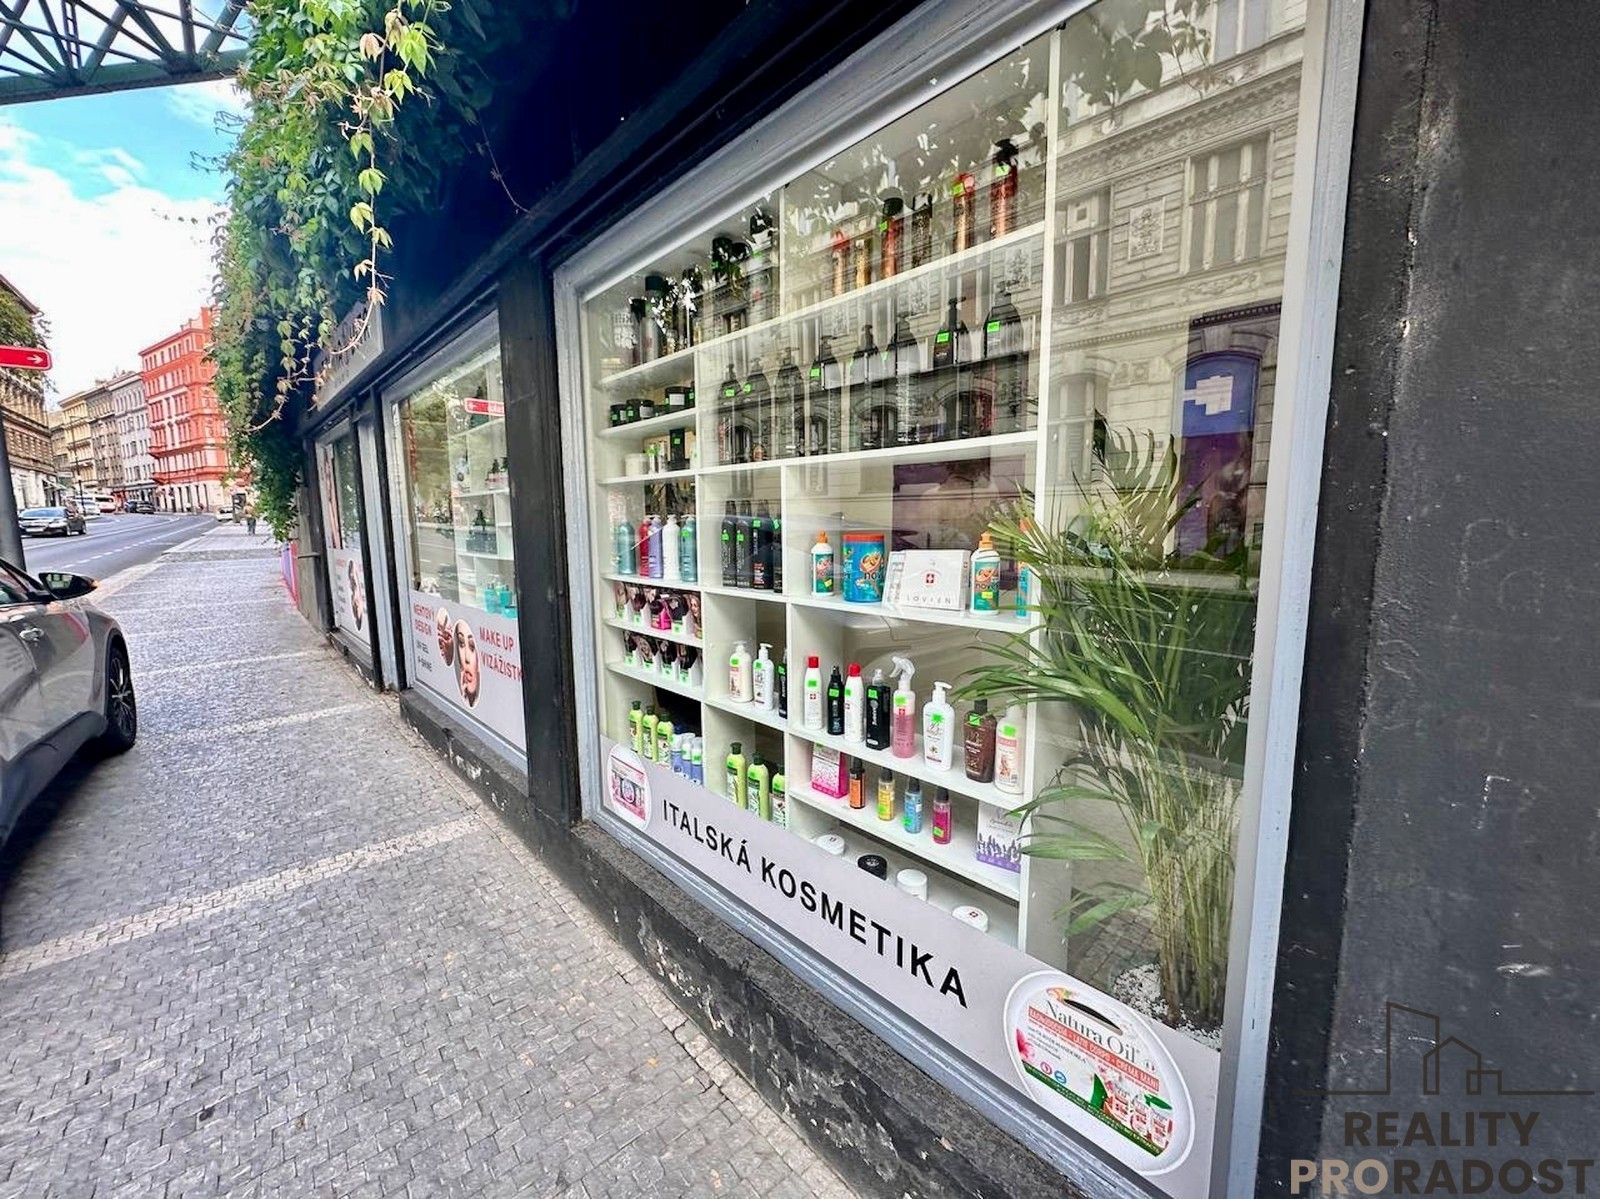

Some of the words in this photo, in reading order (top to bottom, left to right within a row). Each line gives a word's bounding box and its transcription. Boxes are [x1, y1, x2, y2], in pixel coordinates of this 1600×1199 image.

[479, 625, 501, 648] MAKE
[502, 634, 514, 652] UP
[662, 800, 752, 881] ITALSKÁ
[760, 855, 968, 1009] KOSMETIKA
[1047, 1000, 1103, 1046] Natura
[1107, 1035, 1136, 1063] Oil
